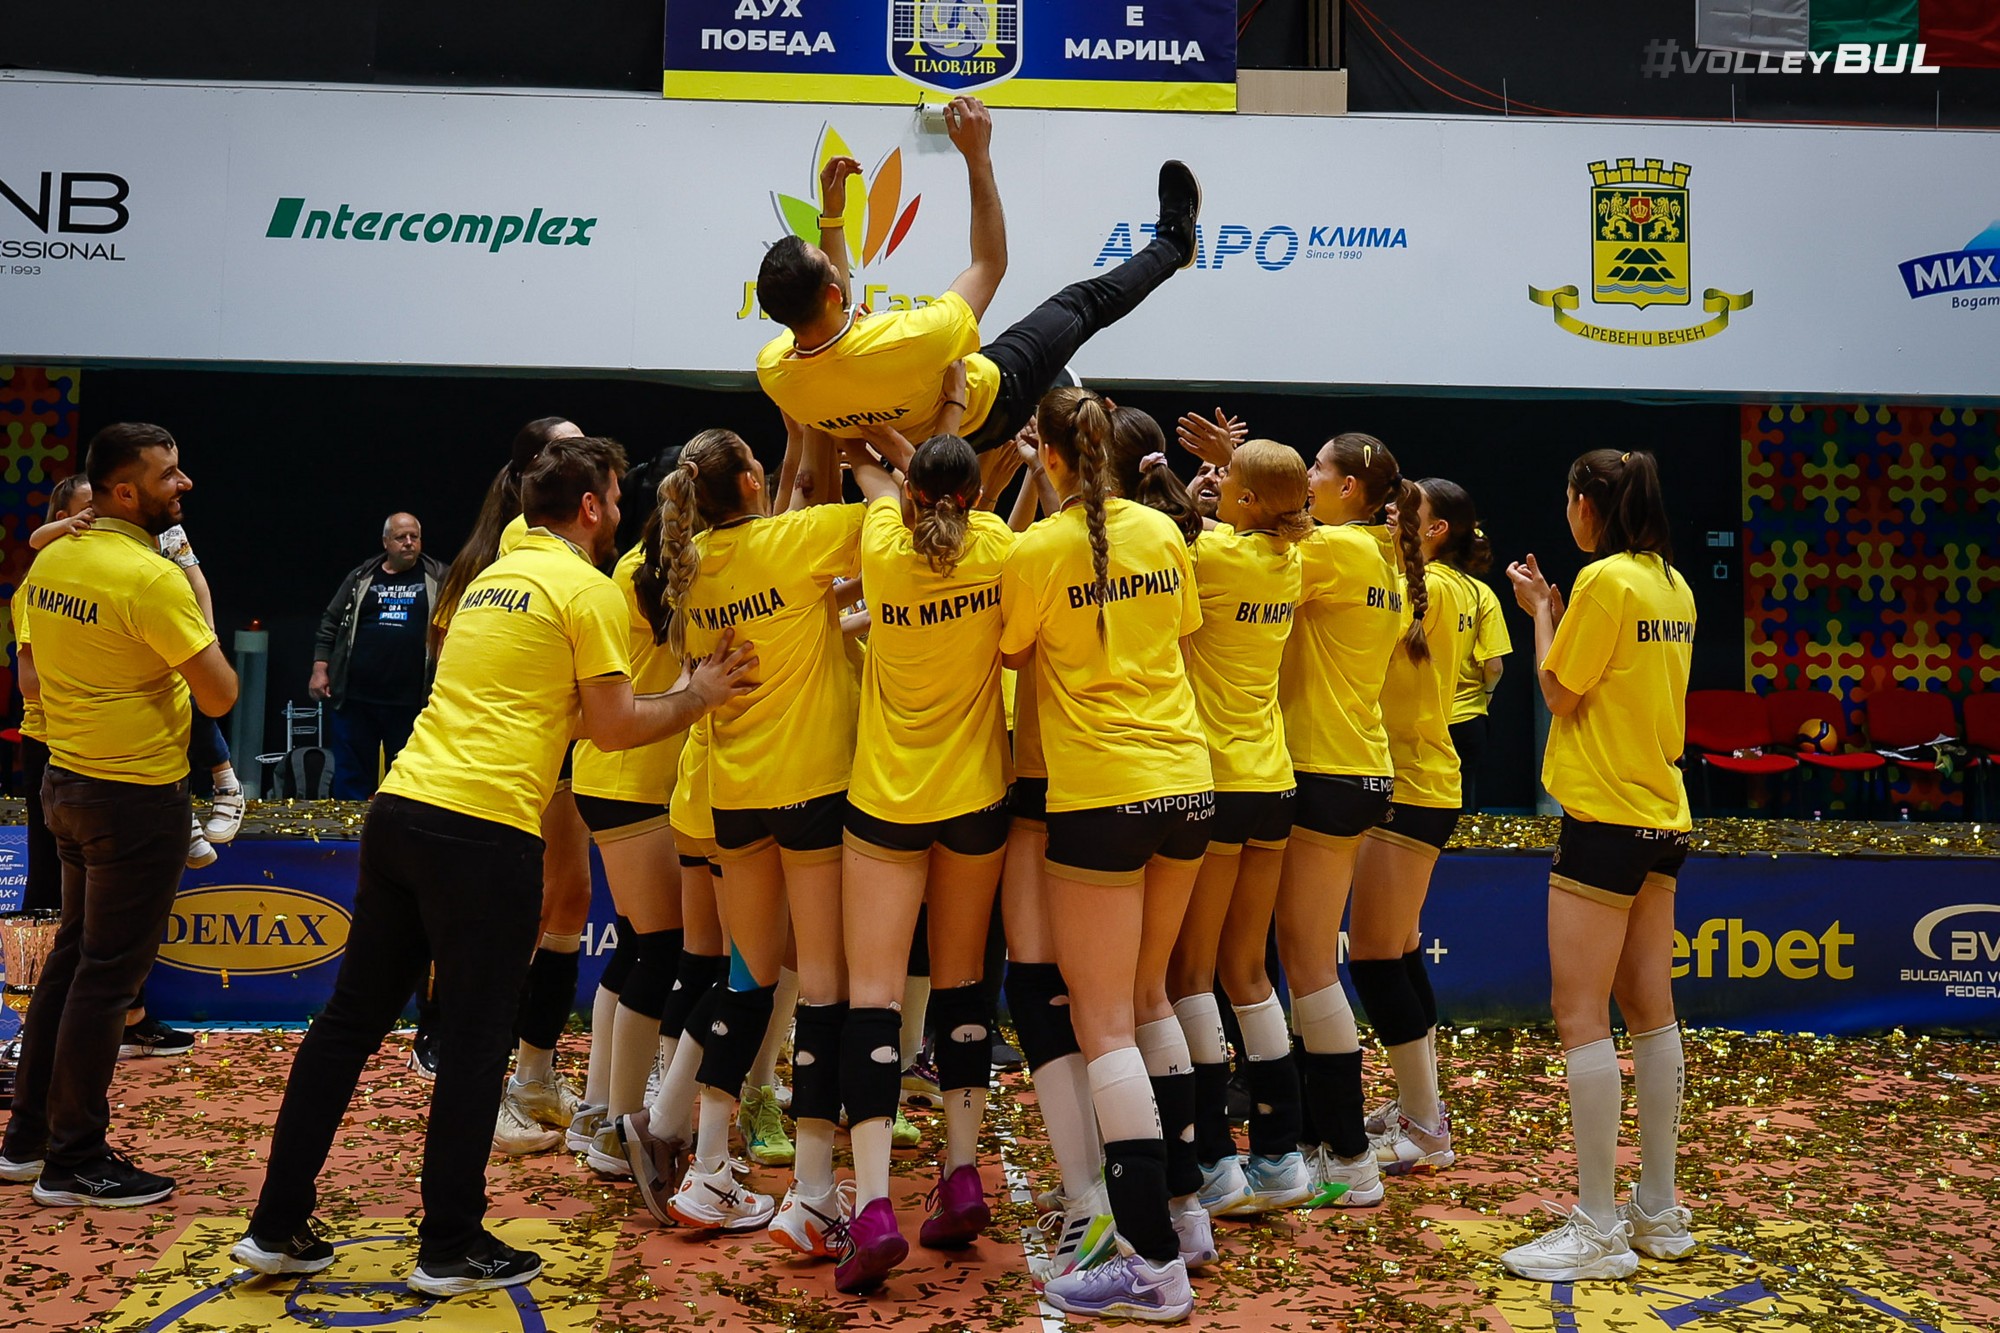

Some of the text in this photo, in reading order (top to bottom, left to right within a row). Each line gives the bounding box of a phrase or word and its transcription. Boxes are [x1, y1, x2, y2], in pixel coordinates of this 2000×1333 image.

[735, 0, 803, 20] ДУХ
[701, 28, 836, 56] ПОБЕДА
[1064, 37, 1205, 65] МАРИЦА
[913, 59, 997, 75] ПЛОВДИВ
[1093, 222, 1299, 271] АРО
[1308, 225, 1408, 249] КЛИМА
[0, 240, 126, 261] SSIONAL
[1305, 249, 1363, 260] Since 1990
[11, 265, 42, 275] 1993
[1913, 255, 2000, 292] МИХ
[1578, 325, 1638, 345] ДРЕВЕН
[1658, 325, 1706, 345] ВЕЧЕН
[461, 588, 531, 613] МАРИЦА
[1067, 567, 1180, 609] ВК МАРИЦА
[1367, 586, 1385, 609] ВК
[37, 587, 98, 625] МАРИЦА
[705, 587, 785, 631] МАРИЦА
[881, 602, 912, 627] ВК
[1235, 600, 1298, 625] ВК МАРИ
[1637, 620, 1694, 644] ВК МАРИ
[160, 914, 329, 946] DEMAX
[1900, 969, 2000, 983] BULGARIAN V
